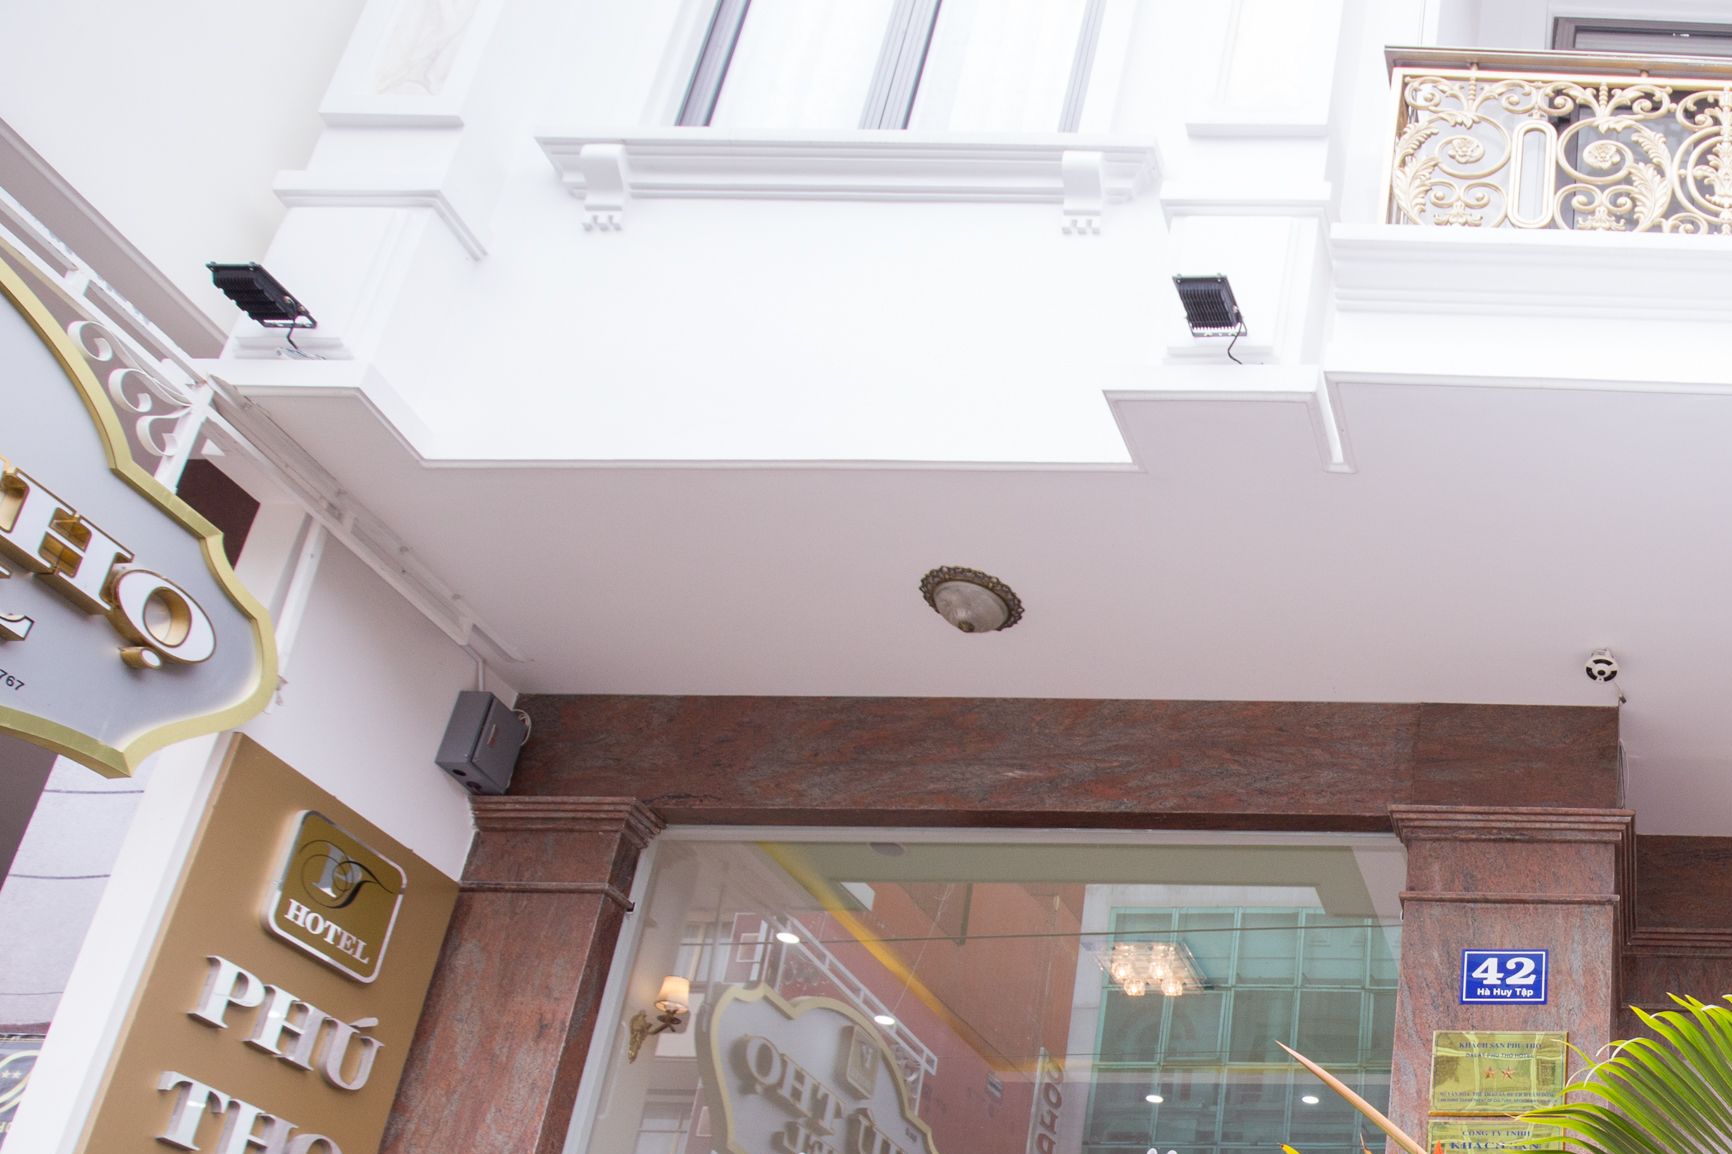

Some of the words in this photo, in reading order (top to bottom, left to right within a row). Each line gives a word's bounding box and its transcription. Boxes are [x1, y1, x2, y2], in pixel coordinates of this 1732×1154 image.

[0, 456, 216, 669] HỌ
[284, 899, 370, 965] HOTEL
[1471, 956, 1537, 985] 42
[1477, 987, 1491, 996] Hà
[1493, 987, 1512, 998] Huy
[1515, 987, 1534, 998] Tập
[186, 954, 386, 1092] PHÚ
